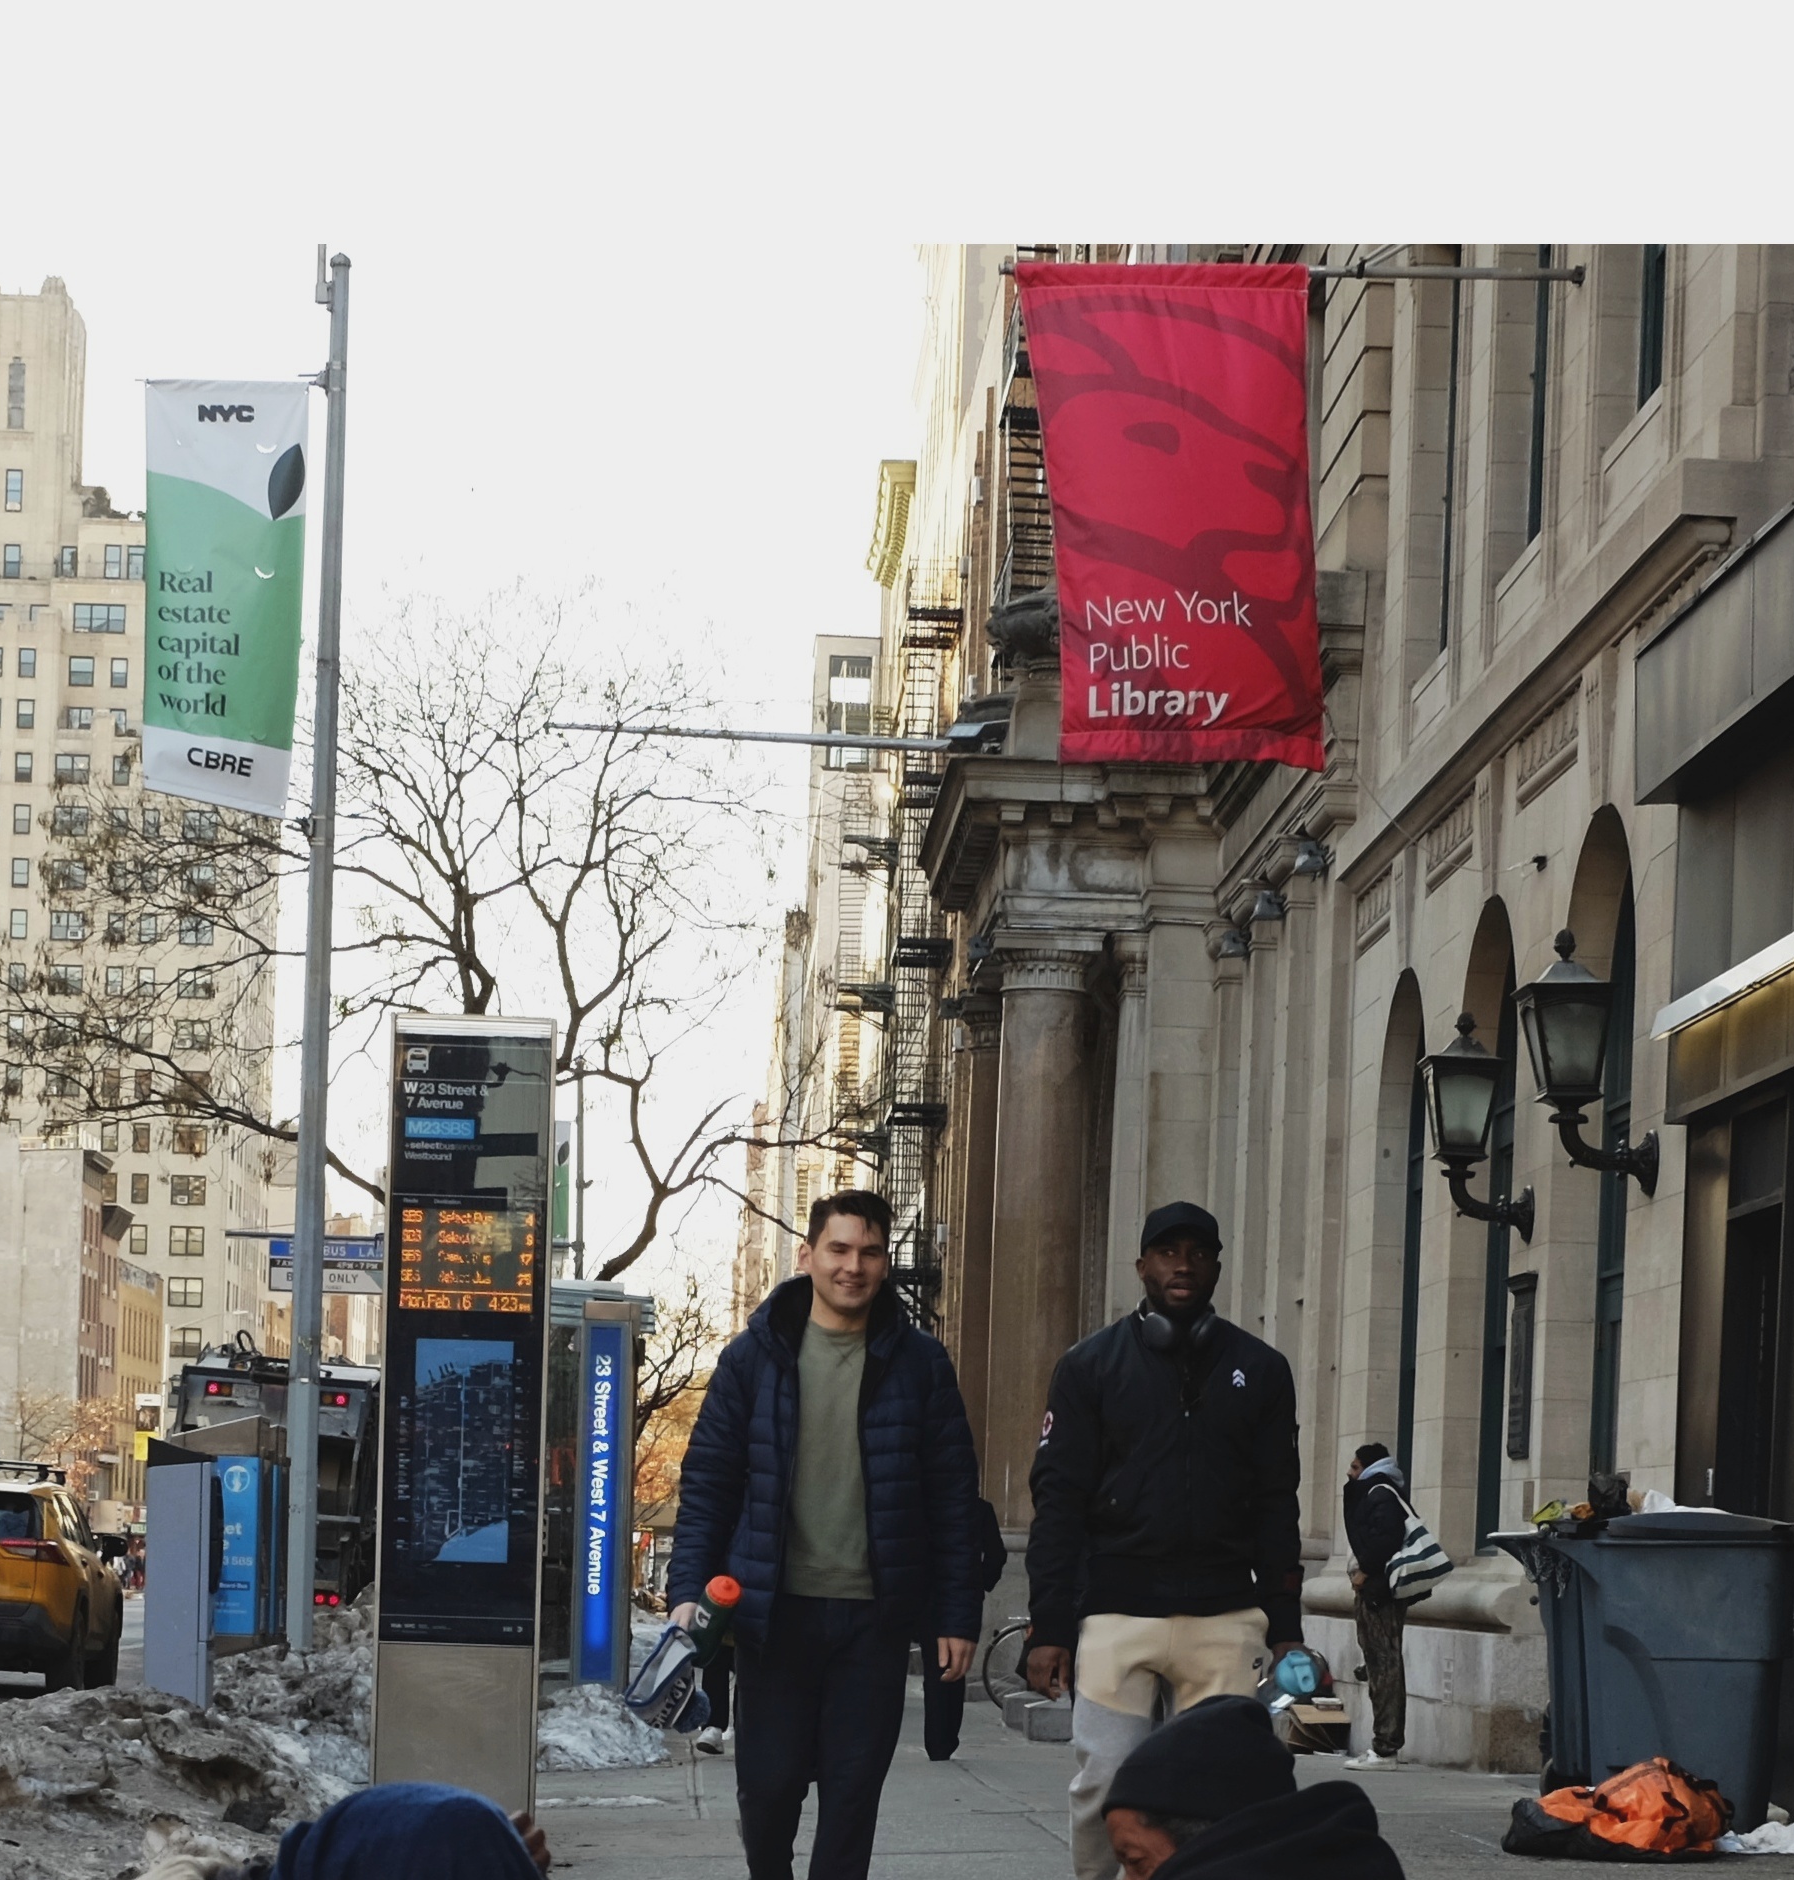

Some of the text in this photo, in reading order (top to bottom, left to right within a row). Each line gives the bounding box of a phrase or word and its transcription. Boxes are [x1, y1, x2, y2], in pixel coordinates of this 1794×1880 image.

[198, 404, 255, 423] NYC
[159, 570, 213, 594] Real
[158, 606, 231, 625] estate
[1085, 590, 1253, 632] New York
[158, 632, 240, 660] capital
[1088, 634, 1190, 674] Public
[158, 662, 226, 686] of the
[159, 692, 226, 718] world
[1089, 682, 1229, 726] Library
[187, 747, 254, 777] CBRE
[403, 1081, 489, 1096] W 23 Street &
[406, 1096, 464, 1109] 7 Avenue
[408, 1121, 471, 1136] M23SBS
[404, 1151, 452, 1161] Westbound
[323, 1246, 346, 1256] BUS
[329, 1273, 359, 1284] ONLY
[587, 1354, 611, 1596] 23 Street & West 7 Avenue
